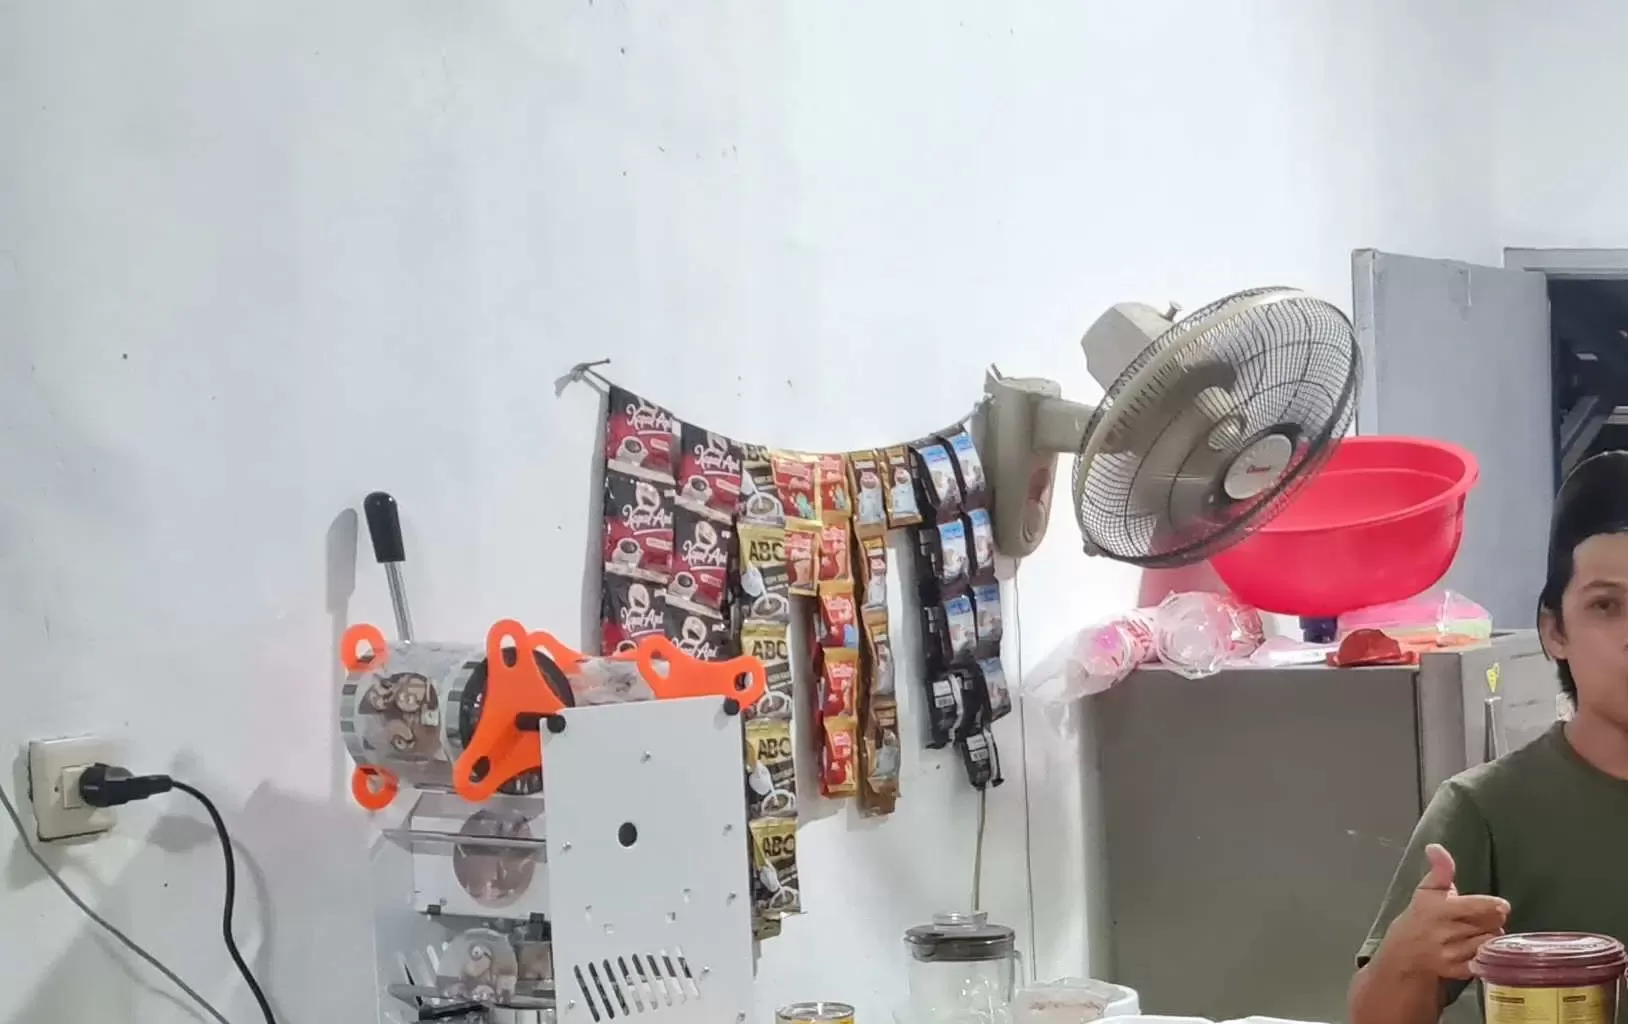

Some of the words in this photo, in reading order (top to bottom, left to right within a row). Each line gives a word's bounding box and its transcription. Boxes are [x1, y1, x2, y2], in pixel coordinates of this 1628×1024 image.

[749, 539, 785, 562] ABC
[751, 639, 788, 661] ABC
[757, 738, 792, 760] ABC
[762, 834, 796, 857] ABC
